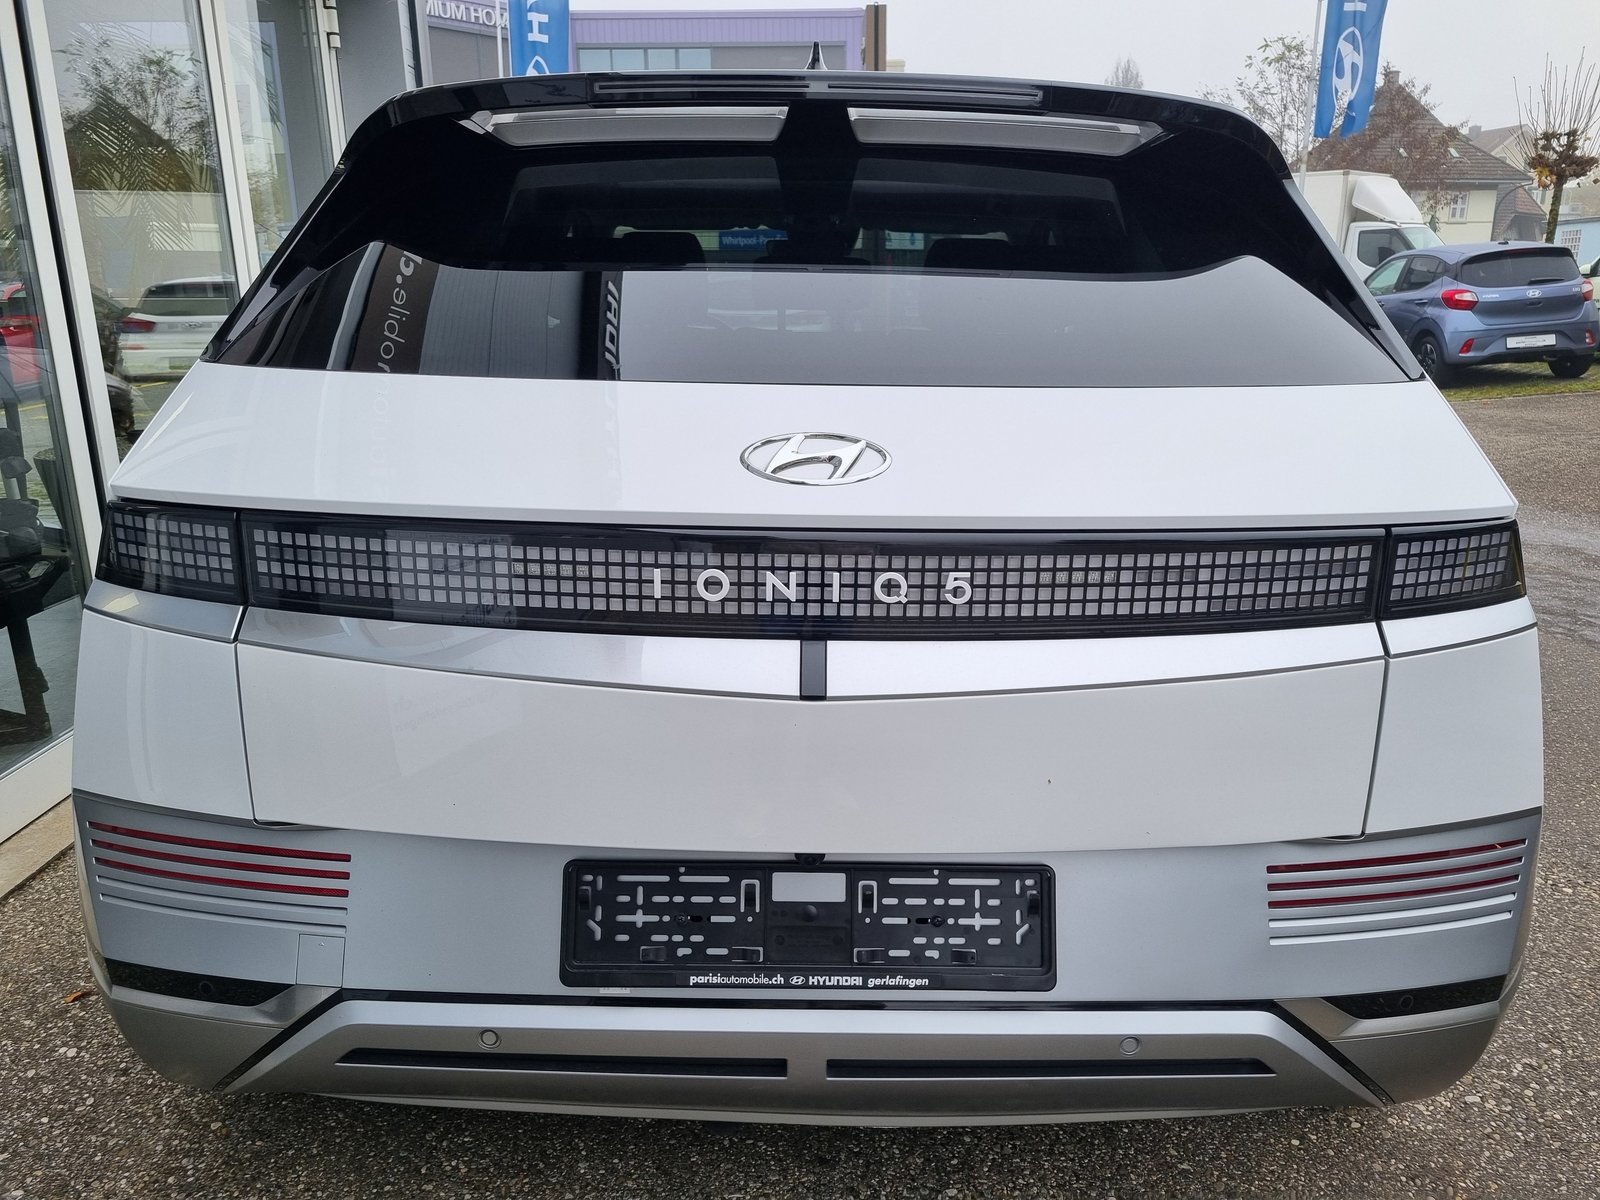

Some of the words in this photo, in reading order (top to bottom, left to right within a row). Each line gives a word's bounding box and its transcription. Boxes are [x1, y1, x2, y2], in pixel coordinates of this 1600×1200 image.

[652, 567, 909, 605] IONIQ
[689, 973, 785, 986] parisiautomobile.ch
[809, 975, 863, 986] HYUNDAI
[867, 975, 930, 988] gerlafingen
